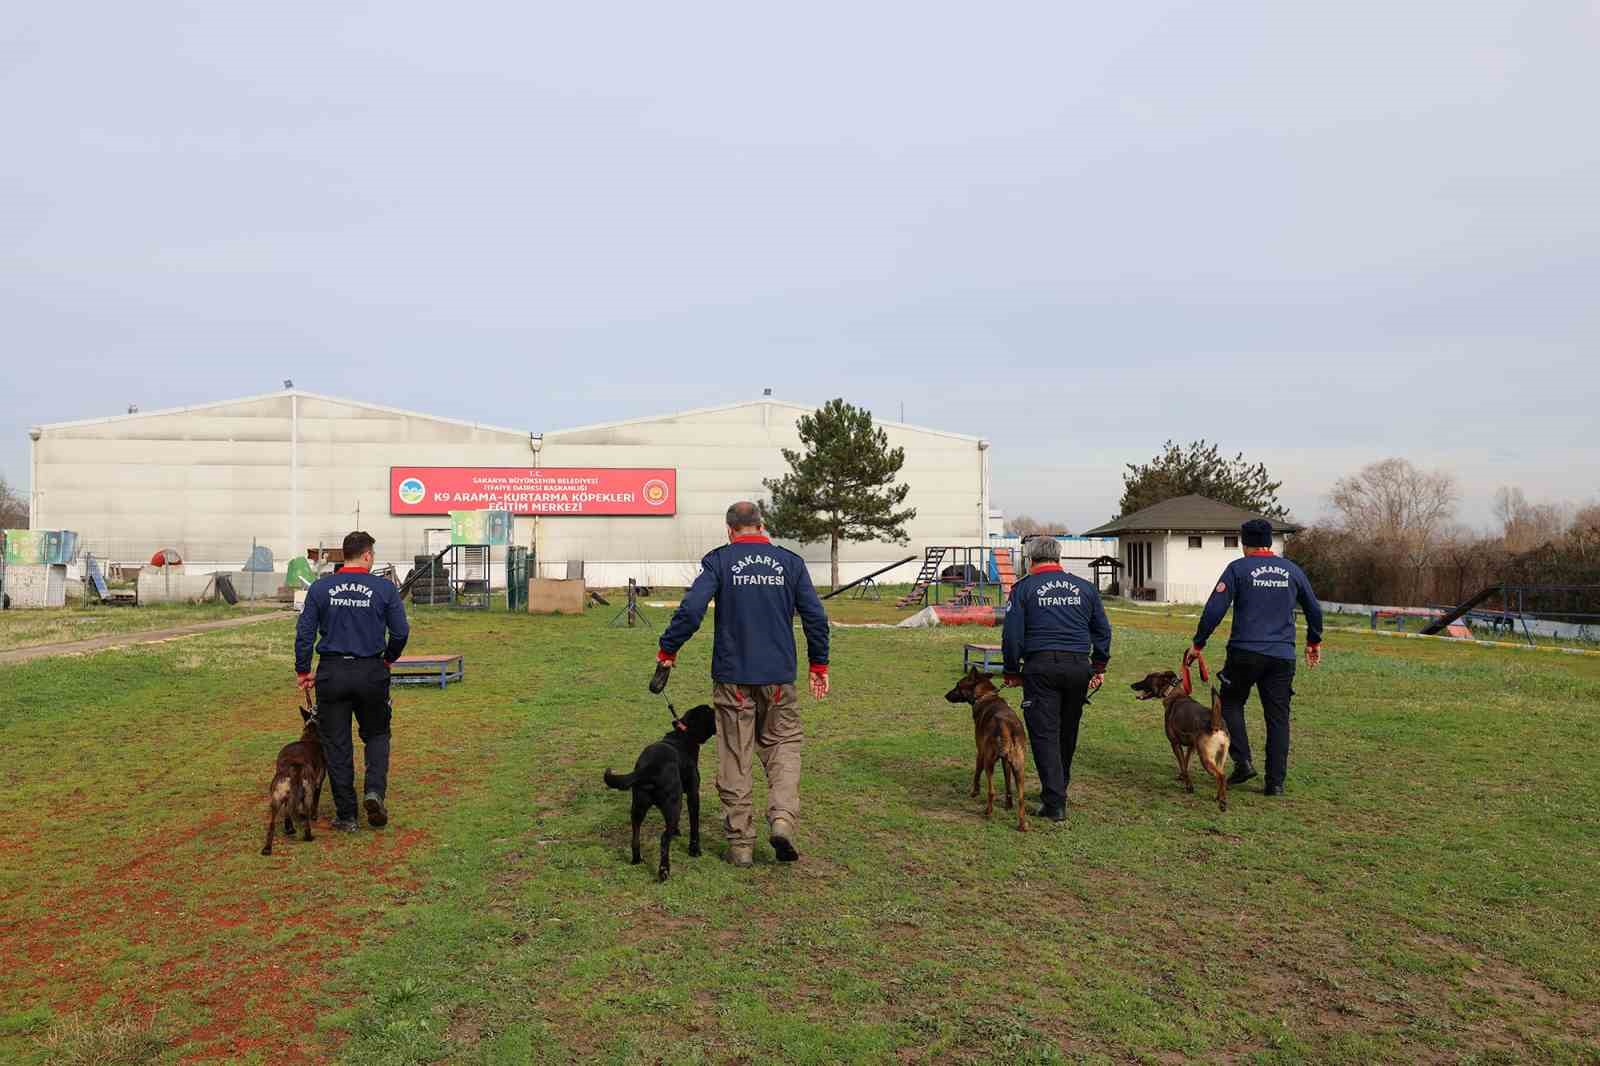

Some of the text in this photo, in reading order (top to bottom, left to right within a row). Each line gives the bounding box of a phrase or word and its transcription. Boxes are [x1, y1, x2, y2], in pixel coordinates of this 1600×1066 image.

[433, 493, 450, 502] K9
[572, 492, 635, 502] KÖPEKLERİ
[489, 502, 583, 511] EĞİTİM MERKEZİ
[731, 554, 784, 575] SAKARYA
[1250, 565, 1290, 579] SAKARYA
[328, 583, 374, 598] SAKARYA
[1036, 580, 1080, 597] SAKARYA
